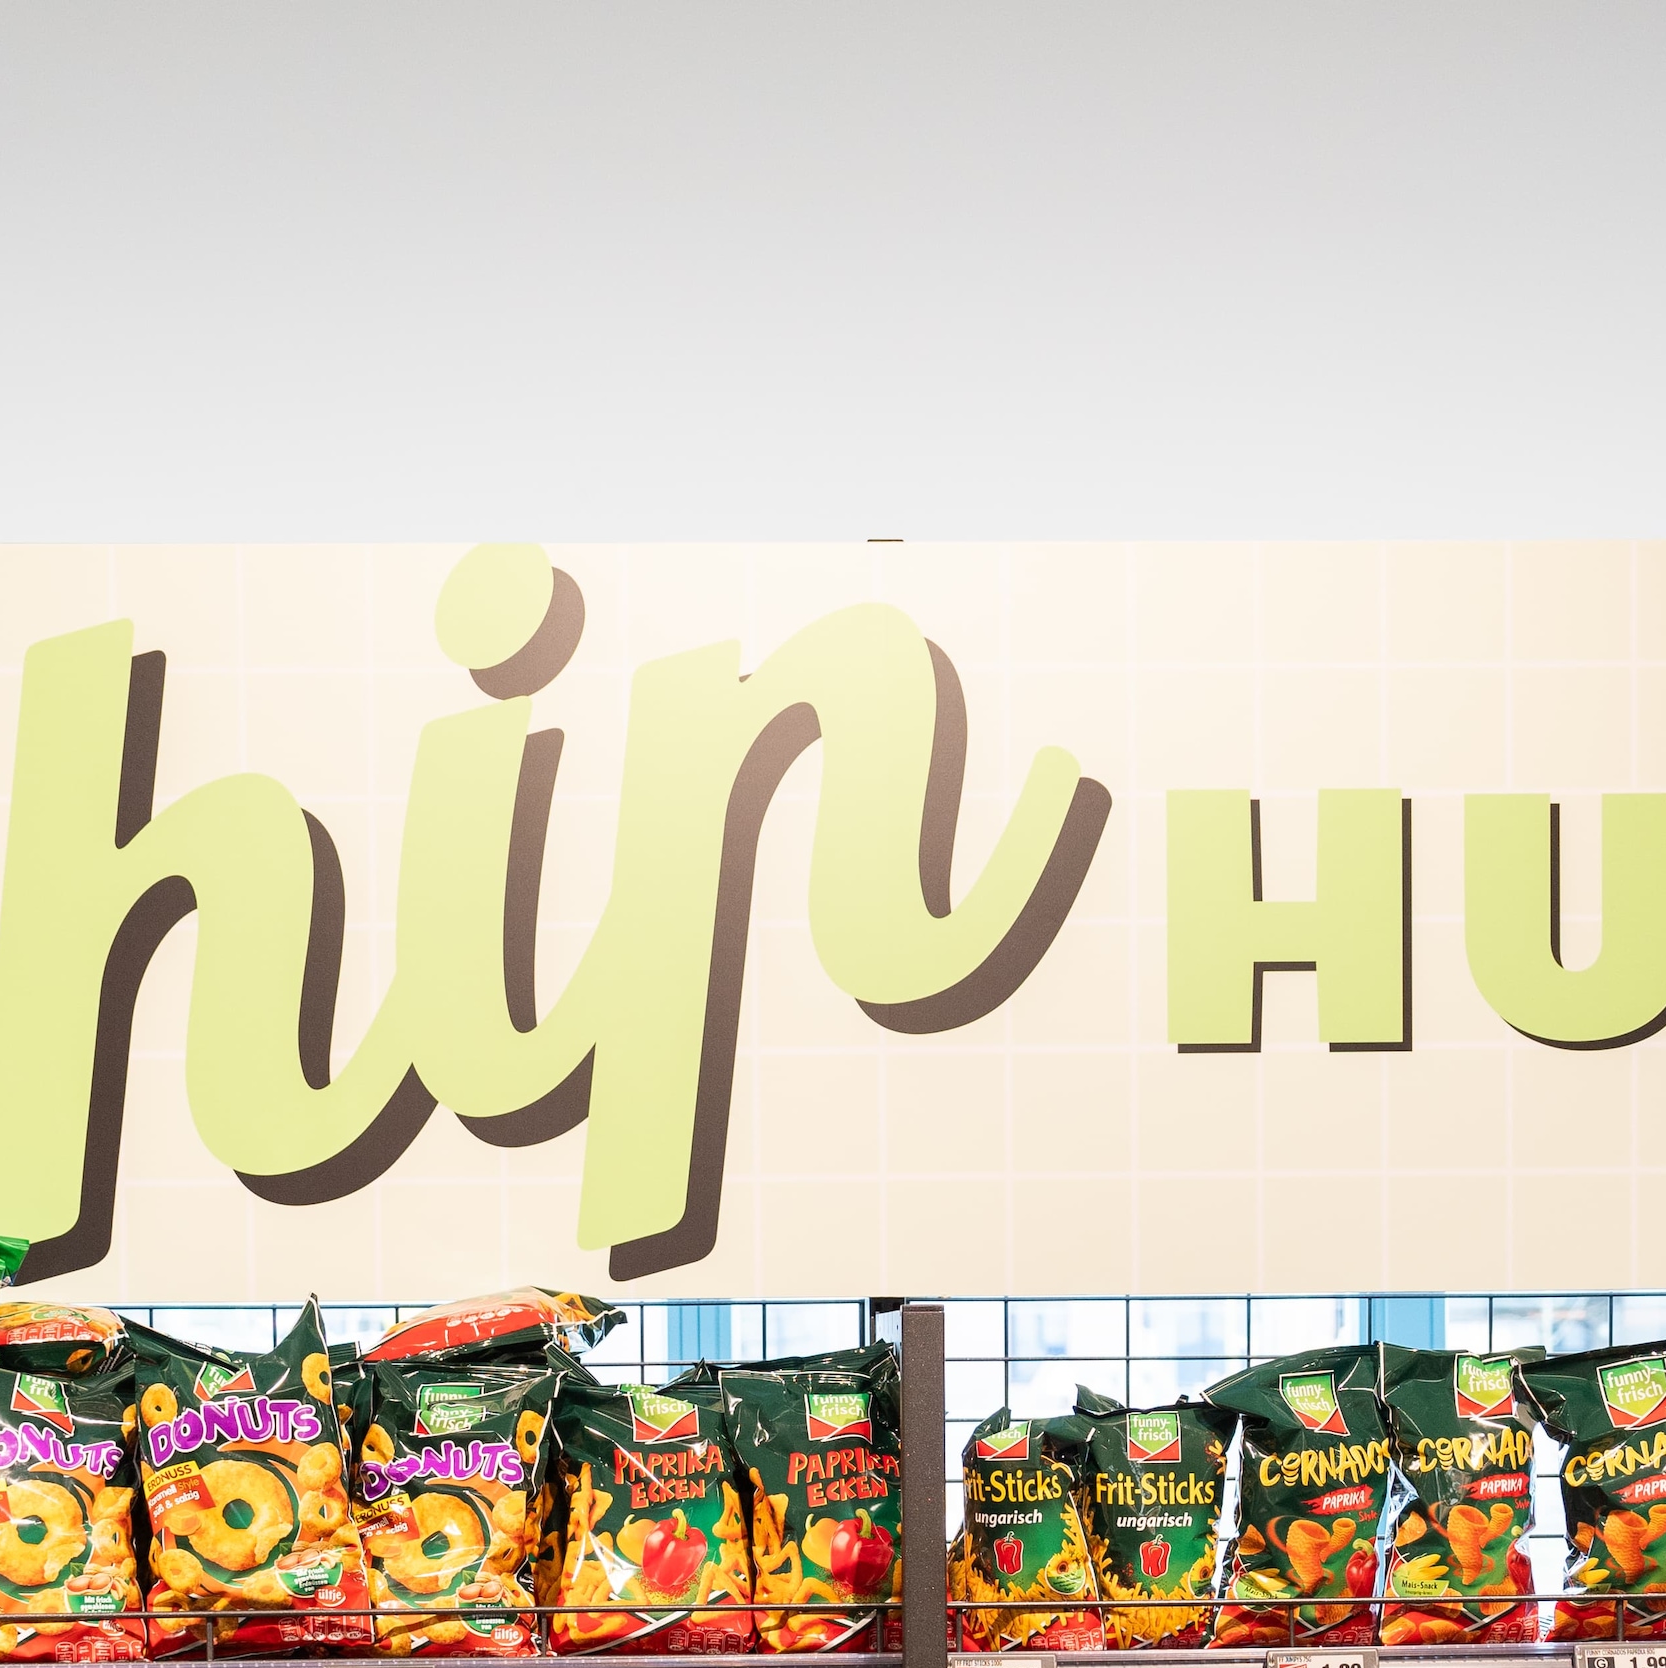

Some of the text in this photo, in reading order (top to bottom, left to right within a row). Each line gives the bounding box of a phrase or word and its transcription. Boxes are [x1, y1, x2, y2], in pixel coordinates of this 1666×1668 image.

[614, 1448, 724, 1484] PAPRIKA
[629, 1477, 706, 1507] ECKEN
[1095, 1472, 1216, 1504] Frit-Sticks
[1116, 1512, 1193, 1531] ungarisch
